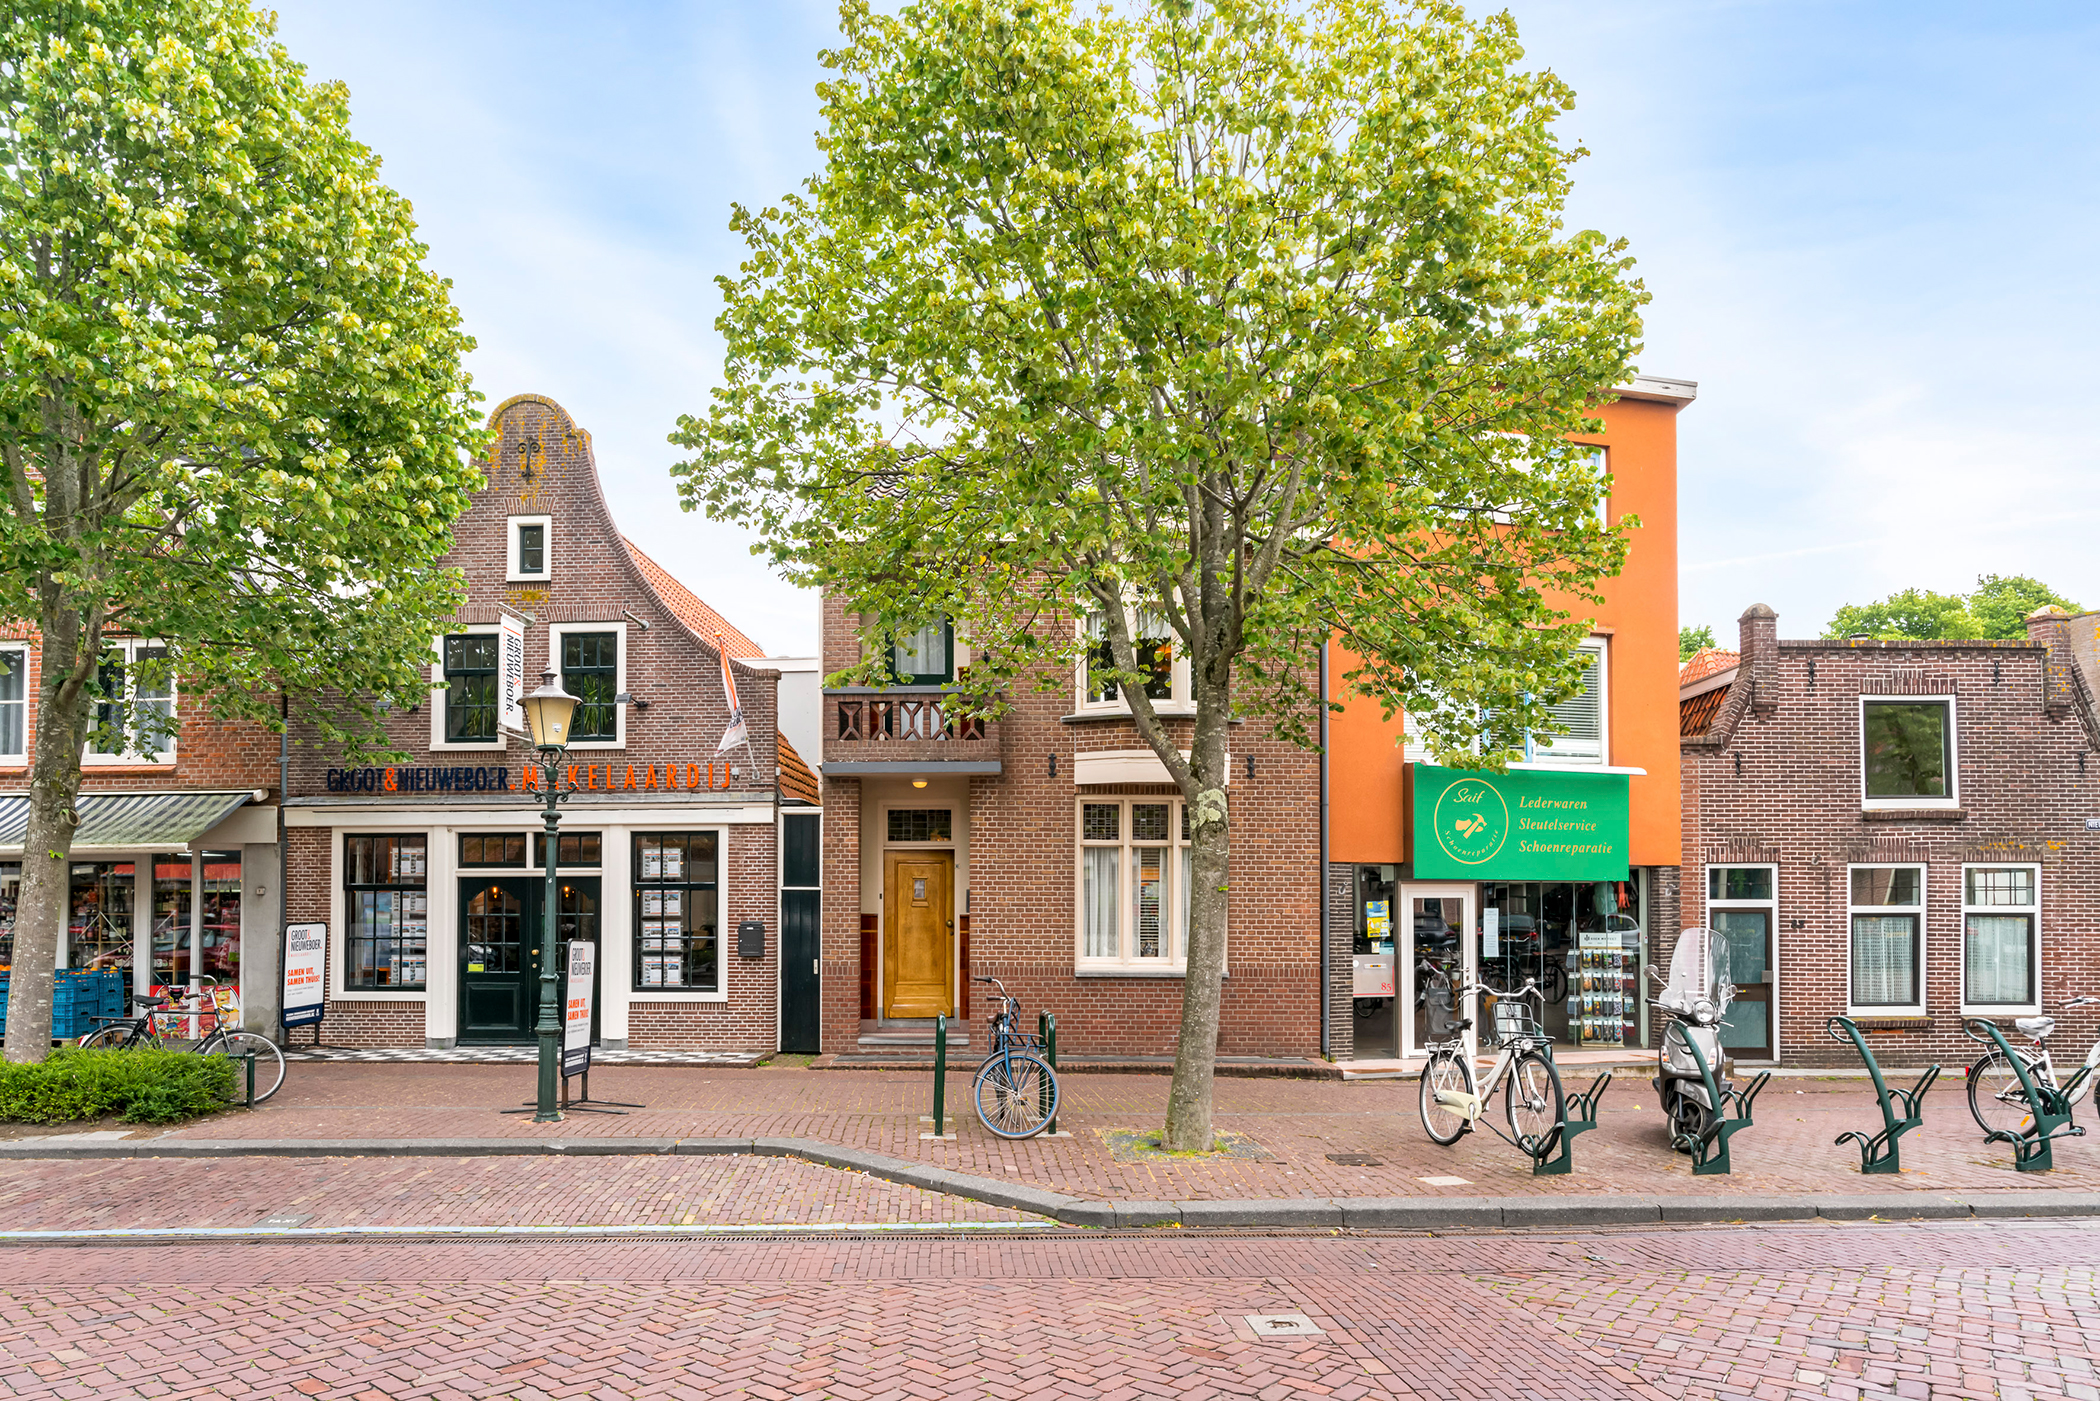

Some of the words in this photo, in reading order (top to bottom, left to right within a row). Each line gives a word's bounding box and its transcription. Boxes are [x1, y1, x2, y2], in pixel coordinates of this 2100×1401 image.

[505, 633, 514, 716] NIEUWEBOER.
[522, 762, 730, 791] MKELAARDIJ
[1453, 787, 1485, 804] Saif
[1519, 795, 1587, 809] Lederwaren
[1518, 817, 1597, 831] Sleutelservice
[1518, 840, 1613, 856] Schoenreparatie
[287, 968, 304, 977] SAMEN
[287, 976, 305, 986] SAMEN
[1381, 982, 1392, 992] 85
